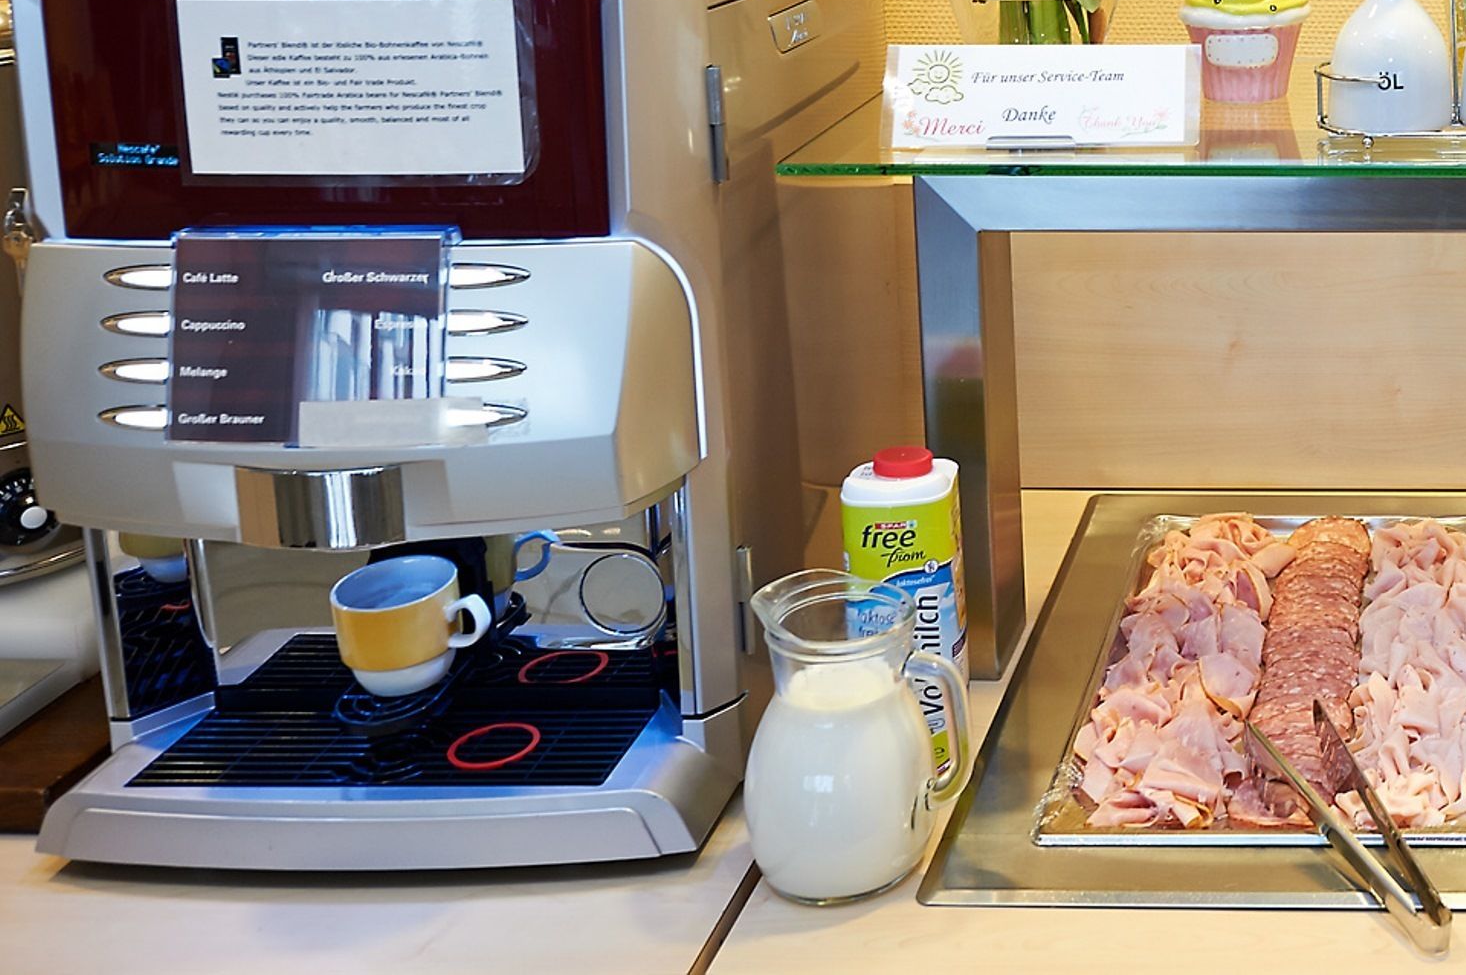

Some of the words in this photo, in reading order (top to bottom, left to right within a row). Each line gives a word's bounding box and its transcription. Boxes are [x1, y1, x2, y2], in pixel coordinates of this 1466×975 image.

[971, 72, 995, 84] Für
[999, 72, 1035, 84] unser
[1038, 69, 1125, 84] Service-Team
[1001, 104, 1057, 124] Danke
[920, 116, 985, 136] Merci
[183, 272, 207, 283] Café
[209, 273, 239, 284] Latte
[322, 271, 364, 283] Großer
[366, 272, 429, 284] Schwarzer
[181, 319, 246, 332] Cappuccino
[179, 366, 228, 379] Melange
[178, 413, 217, 424] Großer
[219, 413, 265, 424] Brauner
[862, 525, 916, 549] free
[881, 547, 926, 568] from
